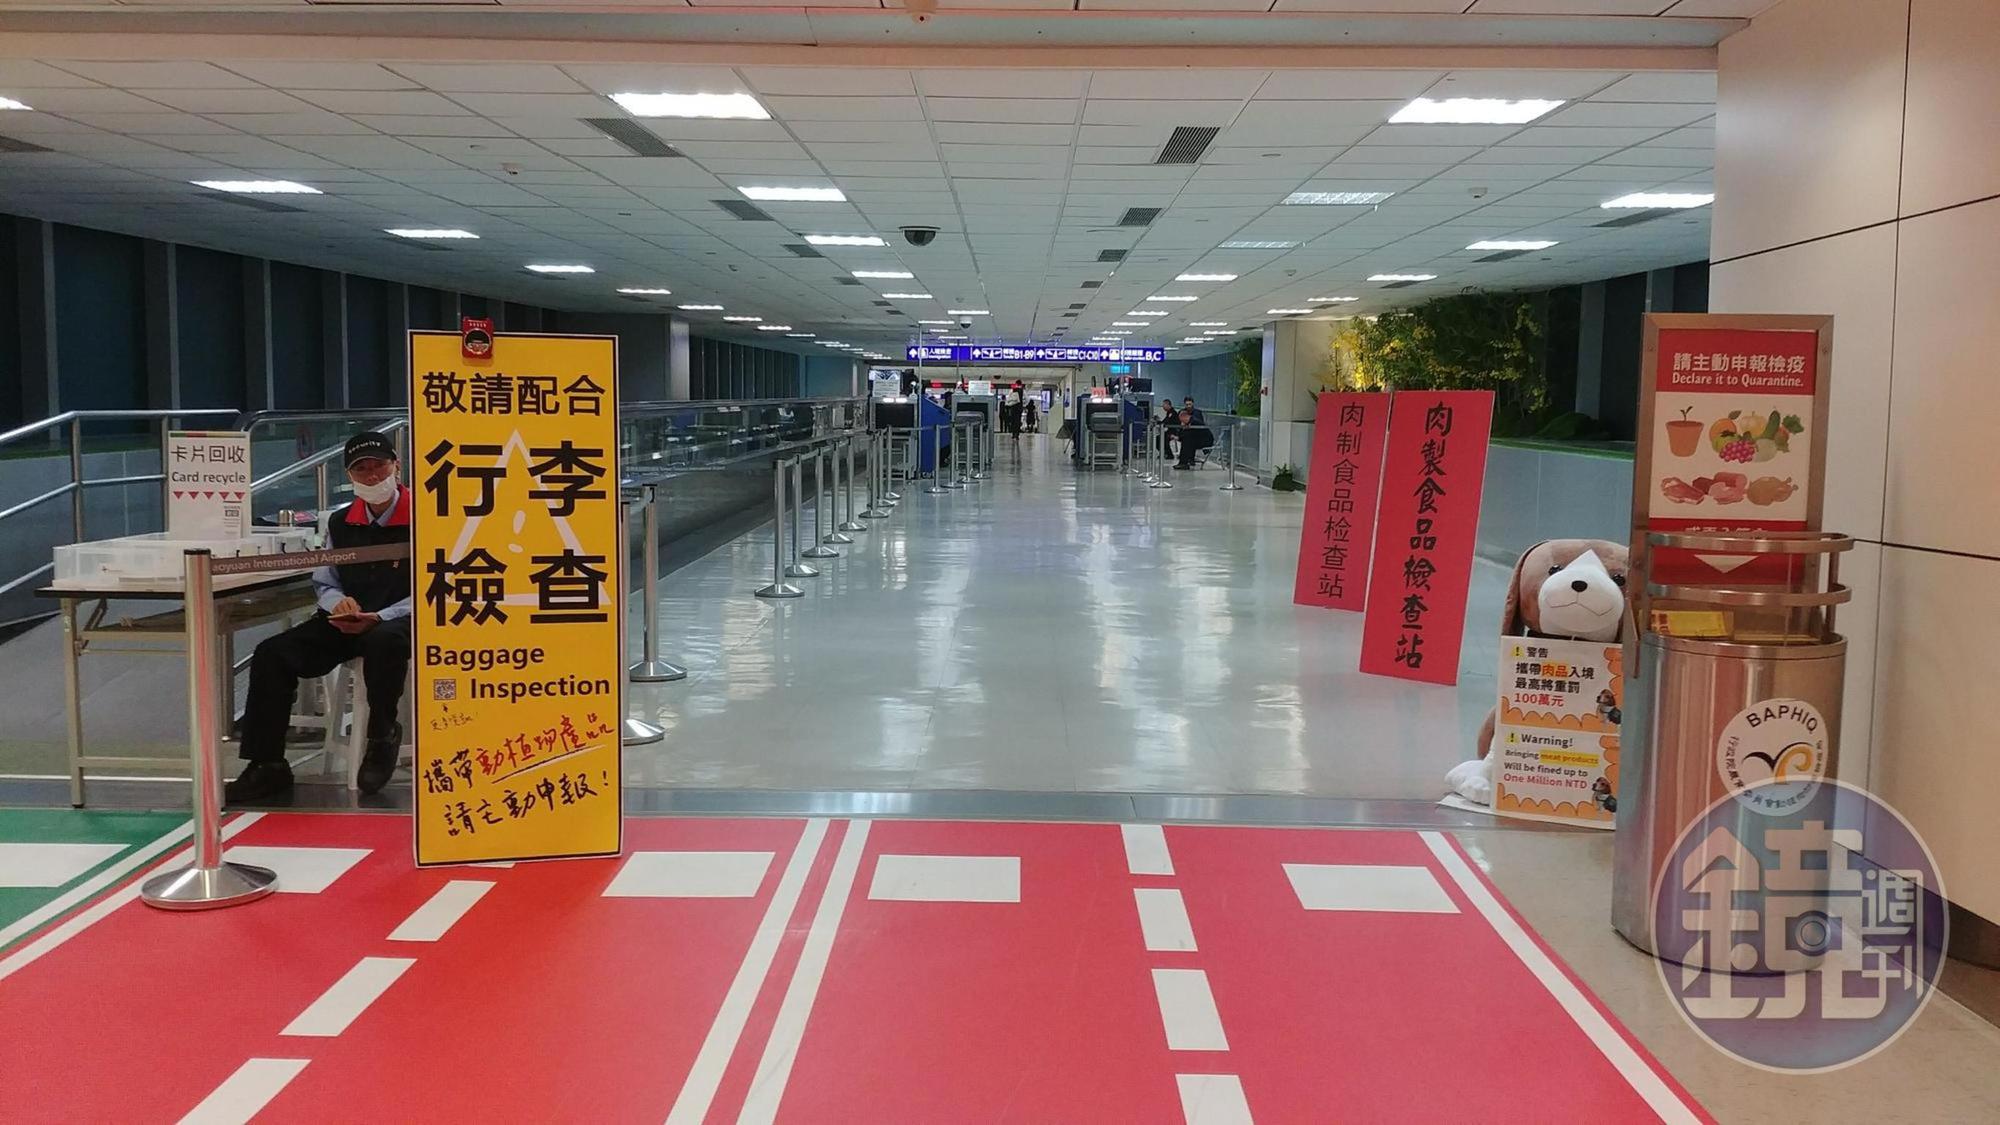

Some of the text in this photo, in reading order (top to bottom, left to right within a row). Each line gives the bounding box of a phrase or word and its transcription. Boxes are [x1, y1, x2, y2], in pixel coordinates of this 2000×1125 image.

[1673, 352, 1805, 374] 請主動申報檢疫
[1672, 372, 1804, 387] Declare it to Quarantine.
[422, 371, 606, 416] 敬請配合
[170, 445, 245, 463] 卡片回收
[172, 471, 246, 486] Card recycle
[424, 439, 607, 518] 行李
[1316, 401, 1365, 599] 肉制食品检查站
[1394, 401, 1453, 669] 肉製食品檢查站
[213, 551, 357, 574] aoyuan International Airport
[425, 548, 608, 626] 檢查
[426, 645, 545, 671] Baggage
[1526, 646, 1549, 659] 警告
[1515, 662, 1595, 680] 攜帶肉品入境
[470, 674, 610, 703] Inspection
[1514, 677, 1581, 694] 最高將重罰
[1513, 692, 1565, 707] 100萬元
[1746, 705, 1818, 734] BAPHIQ
[1521, 733, 1574, 749] Warning!
[1505, 749, 1599, 766] Bringing meat products
[1504, 762, 1522, 771] Will
[1523, 764, 1535, 772] be
[1537, 765, 1562, 775] fined
[1564, 768, 1577, 778] up
[1503, 773, 1588, 789] One Million NTD
